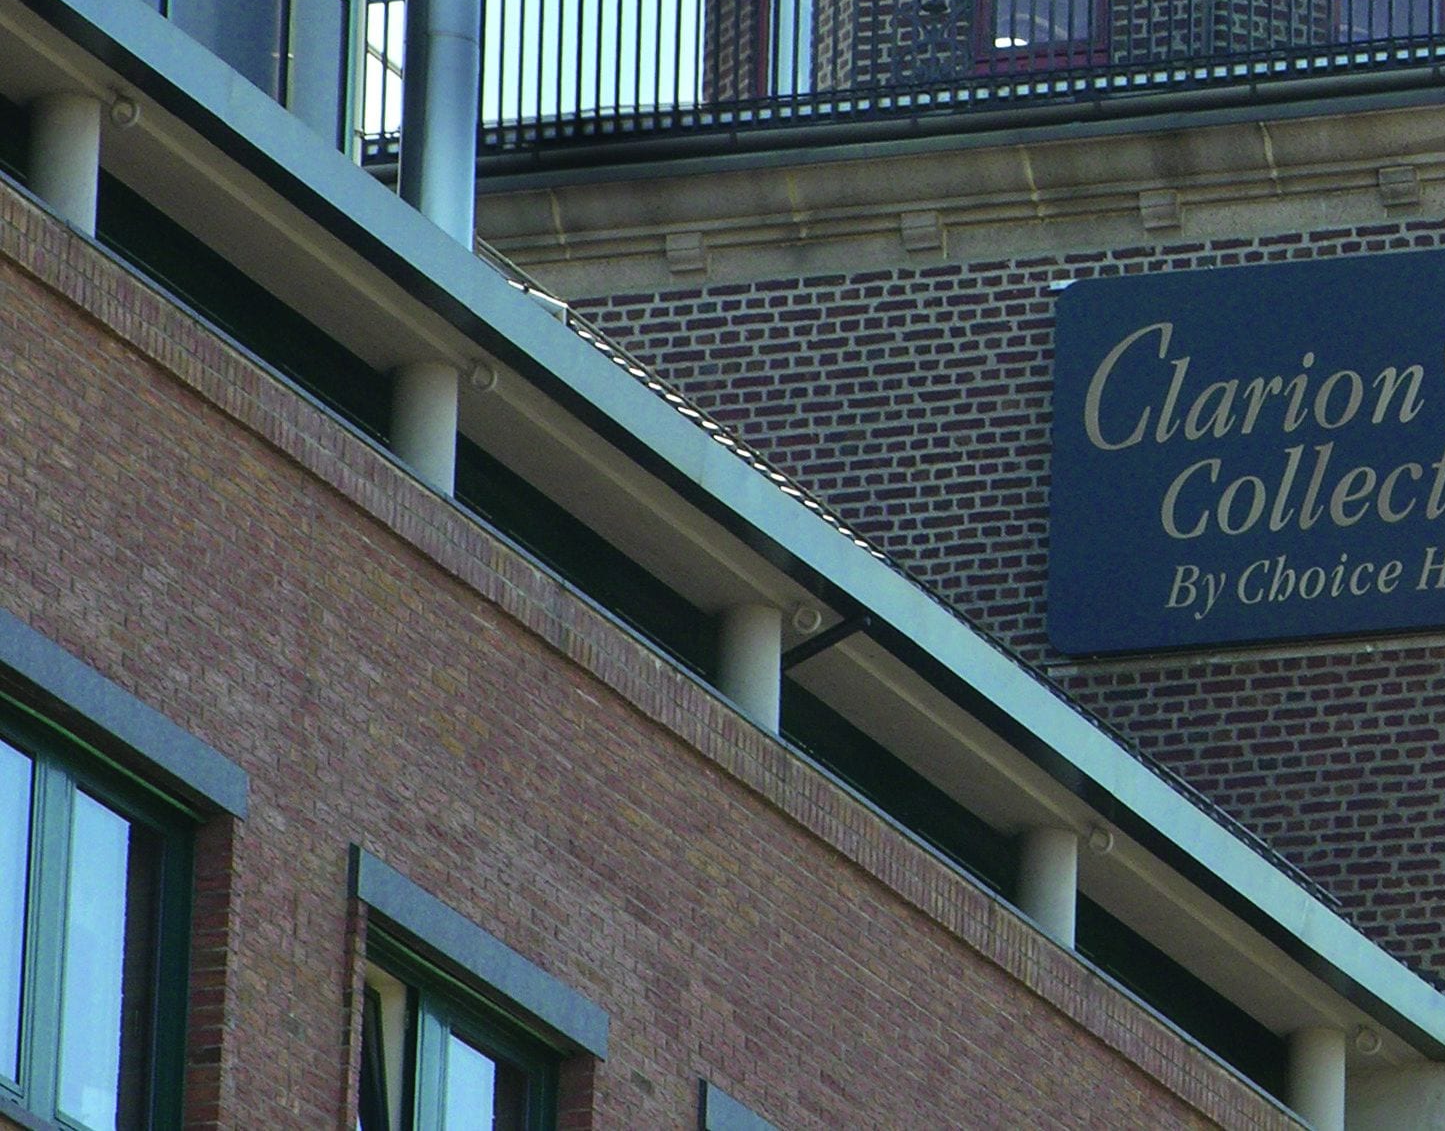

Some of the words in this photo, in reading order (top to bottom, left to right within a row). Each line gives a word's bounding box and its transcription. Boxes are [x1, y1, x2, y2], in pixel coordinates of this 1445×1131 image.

[1083, 323, 1424, 451] Clarion
[1165, 565, 1226, 619] By
[1237, 554, 1401, 604] Choice
